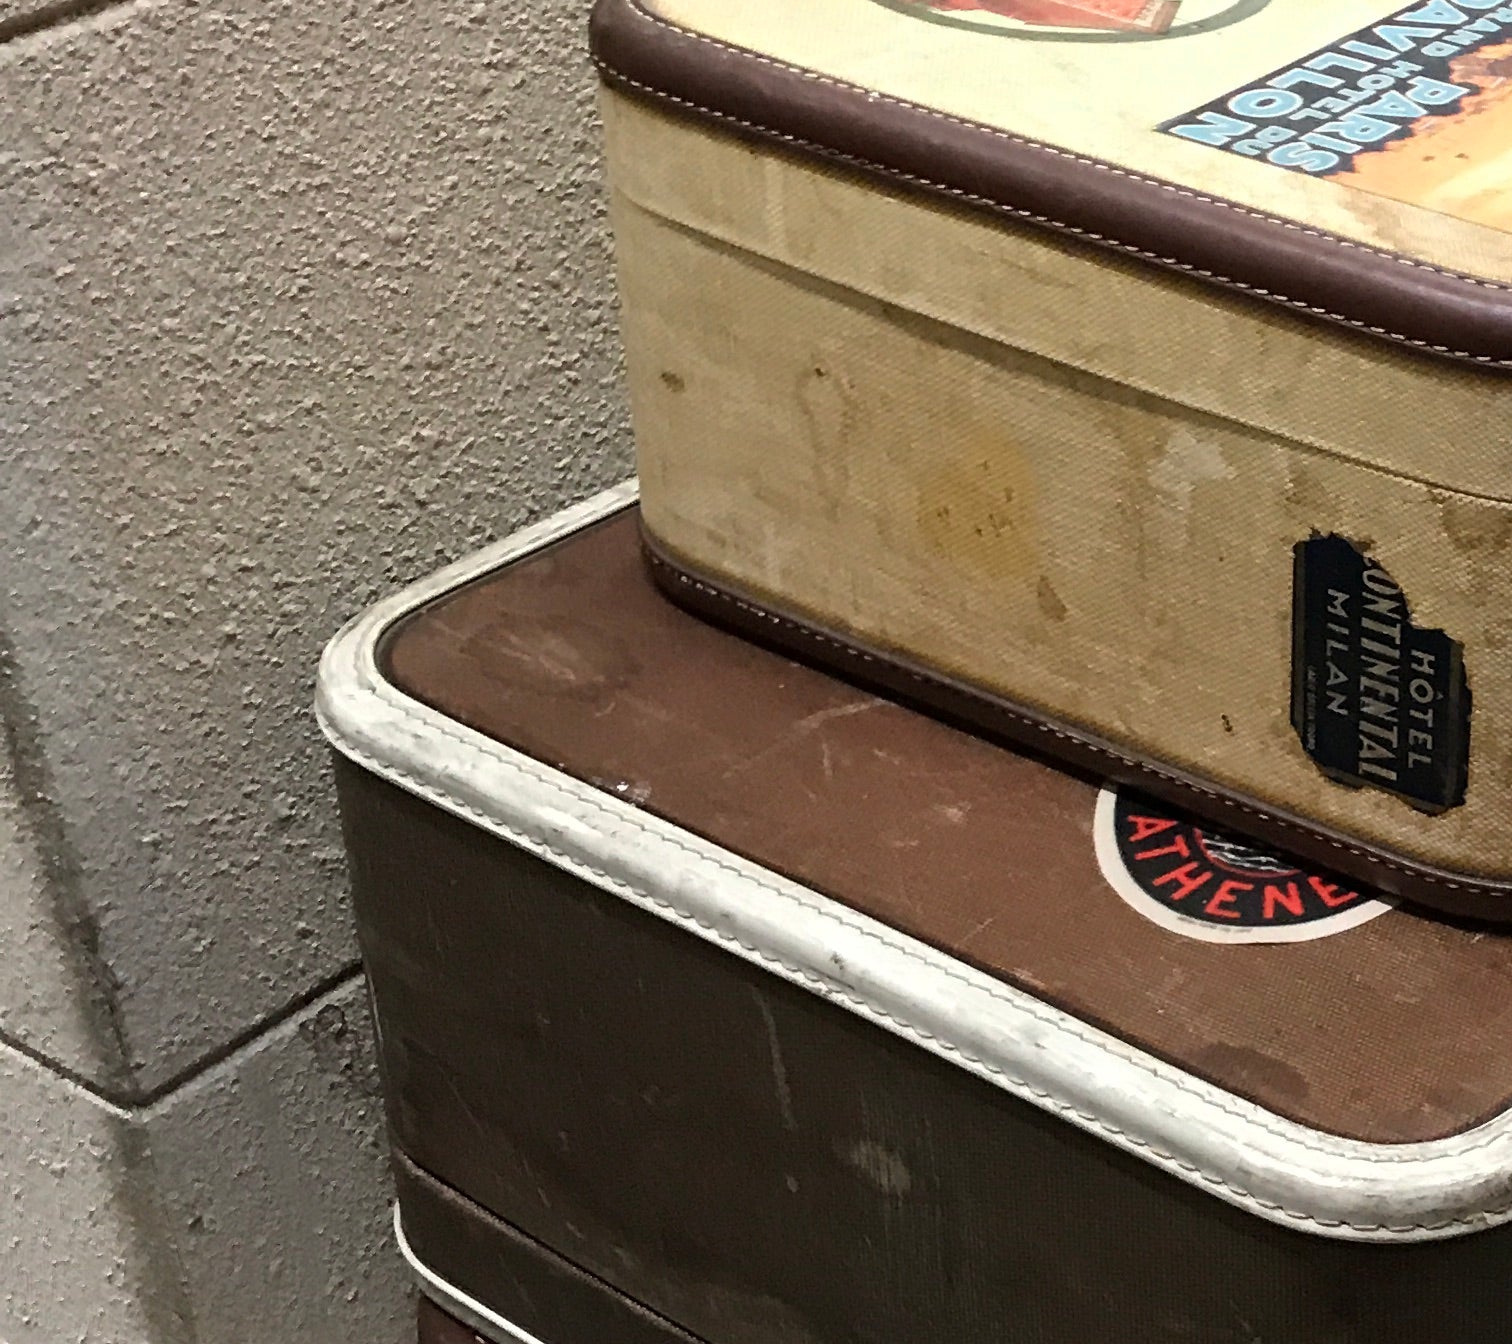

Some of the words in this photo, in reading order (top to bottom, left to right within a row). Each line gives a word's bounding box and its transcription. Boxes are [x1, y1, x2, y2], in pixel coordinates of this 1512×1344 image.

[1266, 75, 1473, 173] PARIS
[1289, 59, 1425, 122] HOTEL
[1232, 125, 1296, 156] DU
[1325, 588, 1351, 716] MILAN
[1407, 648, 1444, 769] HÔTEL
